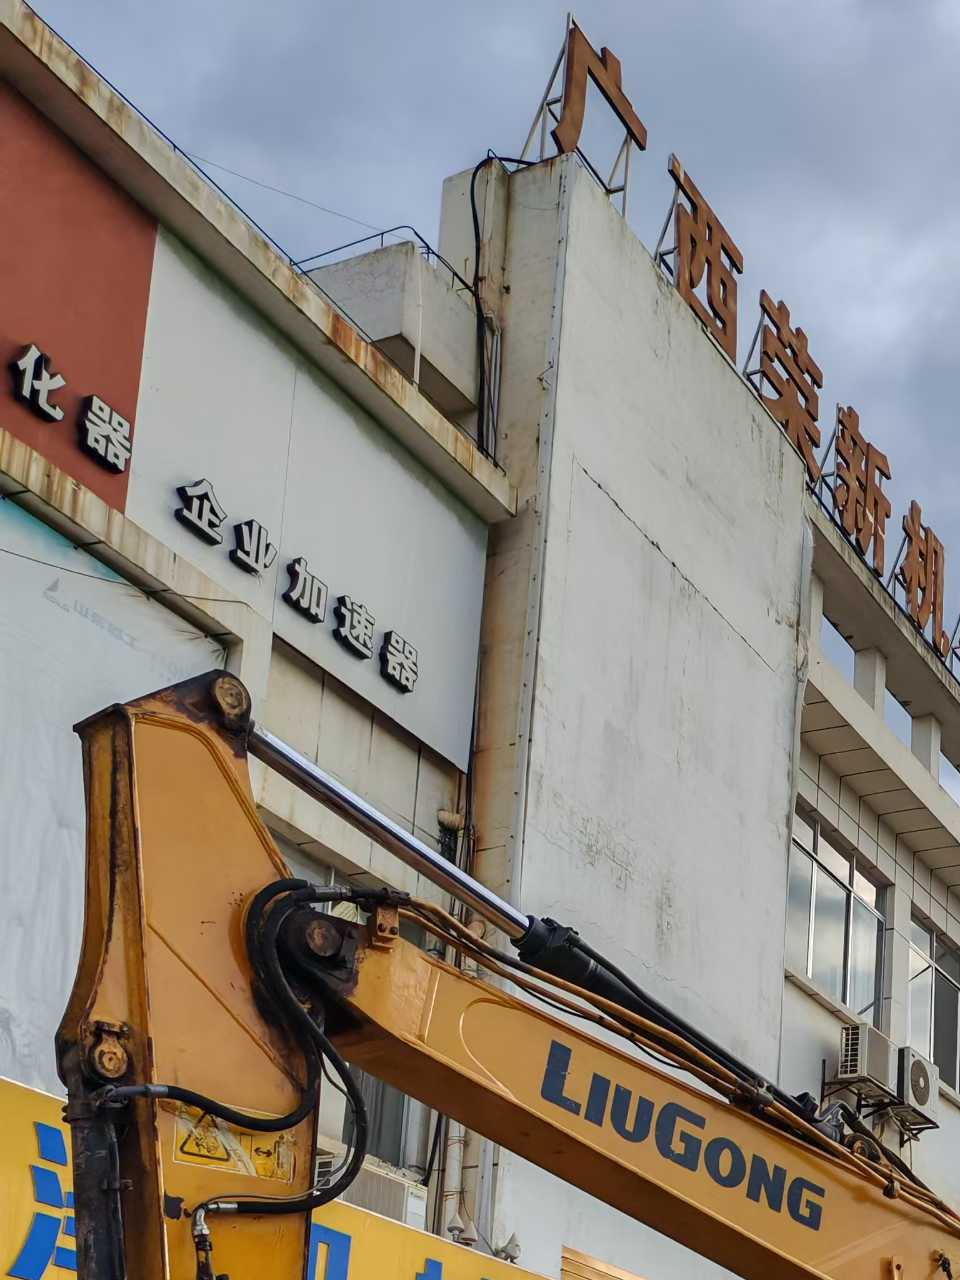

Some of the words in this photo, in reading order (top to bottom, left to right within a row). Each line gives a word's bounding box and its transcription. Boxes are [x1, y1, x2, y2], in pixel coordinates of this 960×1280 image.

[11, 343, 132, 474] 化器
[174, 478, 419, 694] 企业加速器
